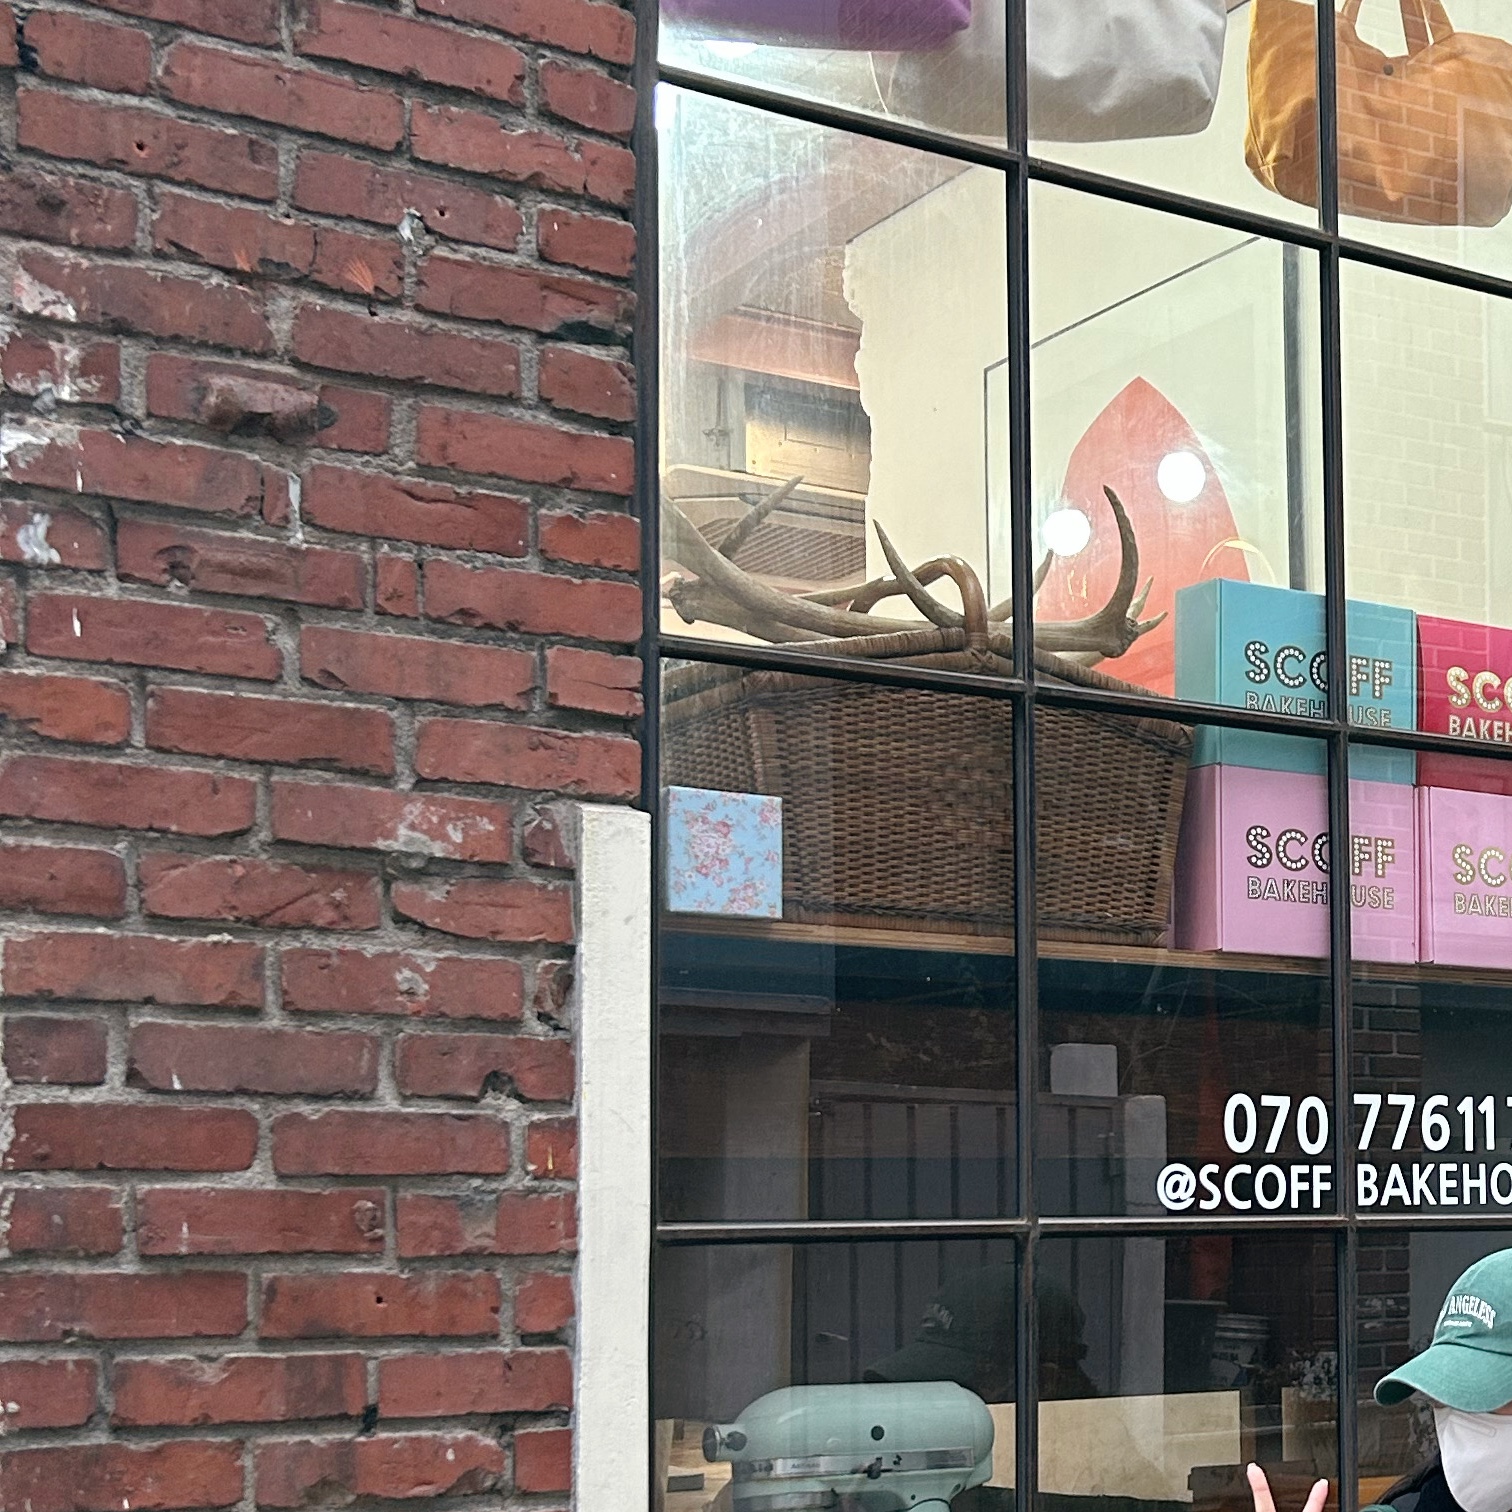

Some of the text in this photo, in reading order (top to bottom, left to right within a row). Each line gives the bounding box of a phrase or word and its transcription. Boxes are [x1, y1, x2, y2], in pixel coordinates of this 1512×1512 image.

[1246, 690, 1391, 728] BAKEHUSE
[1247, 875, 1394, 910] BAKEHUSE
[1223, 1092, 1329, 1155] 070
[1156, 1162, 1332, 1211] @SCOFF
